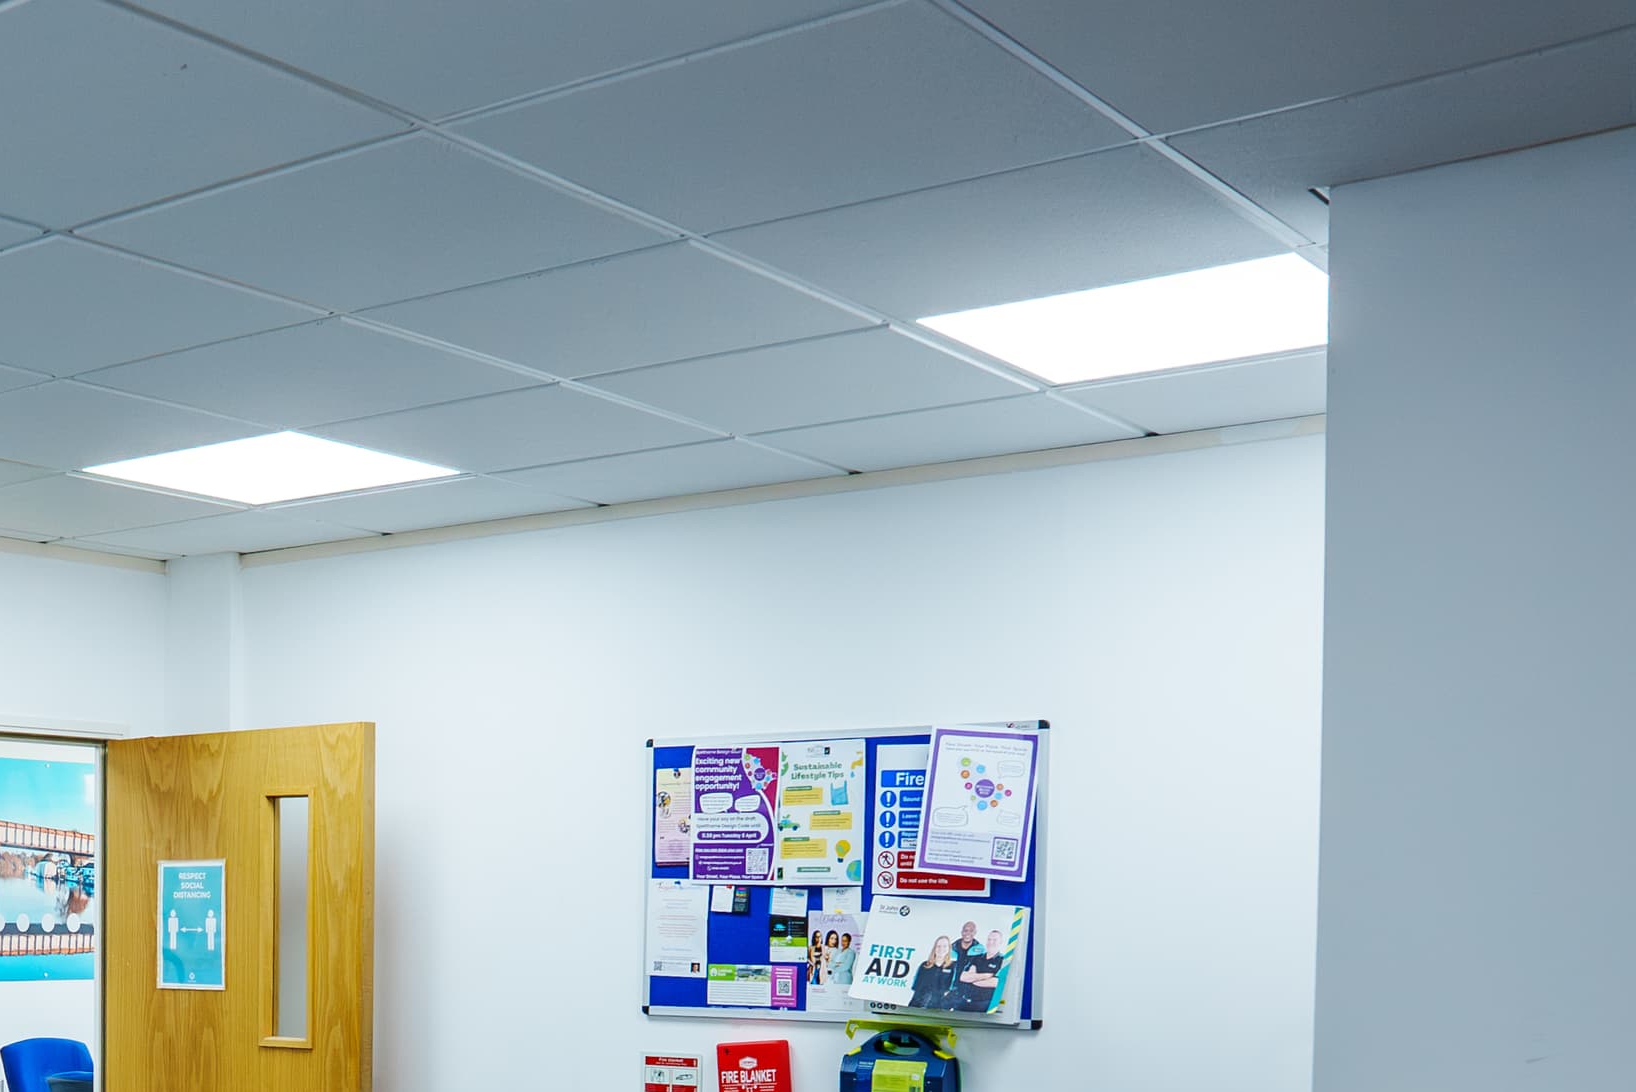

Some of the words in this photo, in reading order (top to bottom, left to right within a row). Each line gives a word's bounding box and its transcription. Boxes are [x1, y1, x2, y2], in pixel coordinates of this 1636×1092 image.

[696, 757, 723, 766] Exciting
[696, 765, 737, 774] community
[793, 762, 842, 771] Sustainable
[695, 774, 742, 783] engagement
[791, 771, 826, 780] Lifestyle
[828, 771, 843, 779] Tips
[896, 772, 924, 785] Fire
[695, 782, 739, 791] opportunity!
[179, 872, 206, 880] RESPECT
[173, 891, 211, 899] DISTANCING
[869, 944, 915, 961] FIRST
[865, 958, 910, 979] AID
[862, 975, 876, 984] AT
[877, 976, 908, 987] WORK
[721, 1071, 739, 1083] FIRE
[740, 1069, 776, 1083] BLANKET
